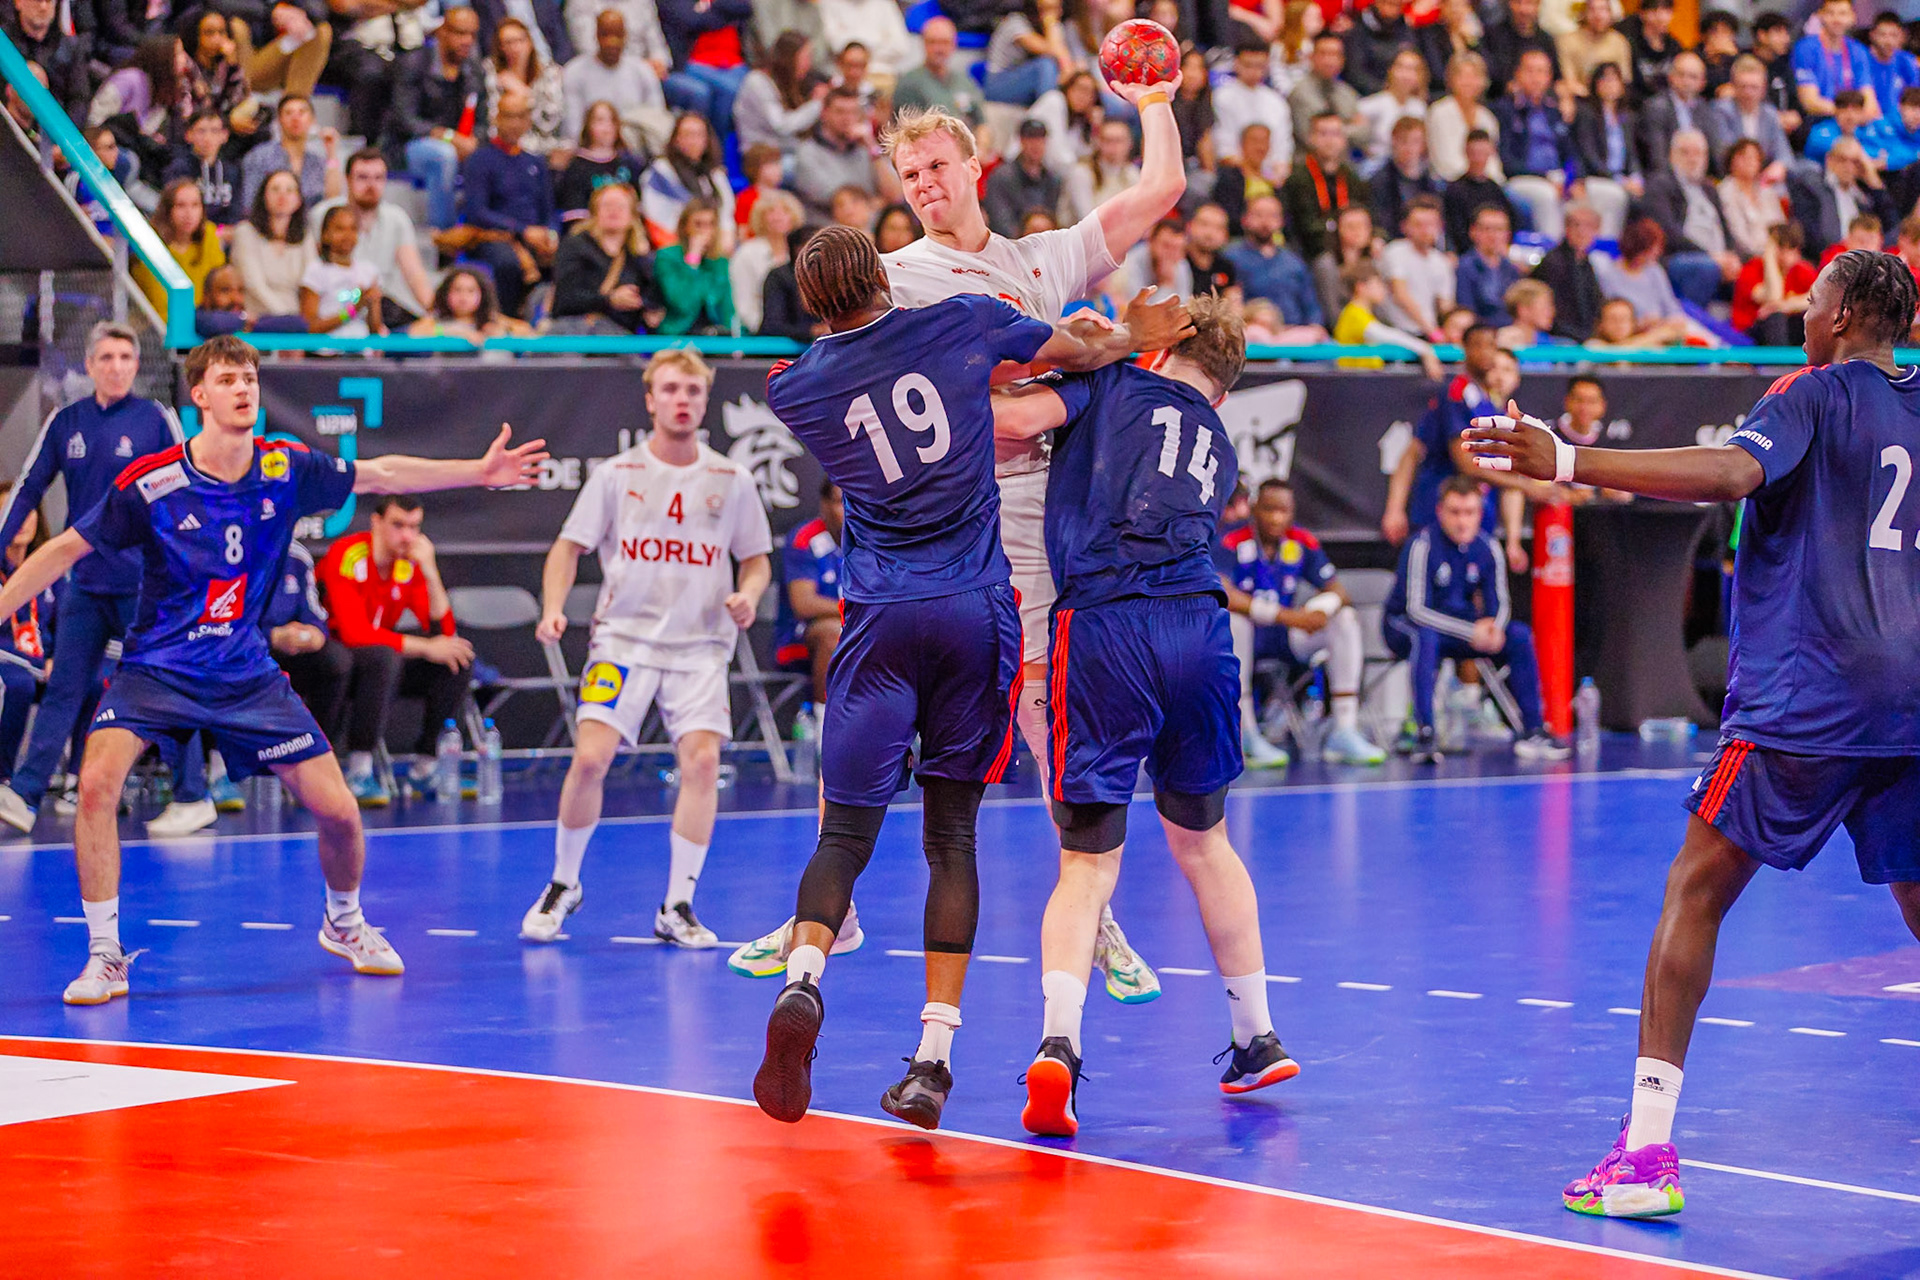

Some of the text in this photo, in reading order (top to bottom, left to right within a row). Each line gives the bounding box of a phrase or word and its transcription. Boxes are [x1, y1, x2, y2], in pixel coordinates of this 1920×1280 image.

[843, 372, 952, 485] 19
[1151, 405, 1219, 506] 14
[667, 491, 685, 525] 4
[1868, 444, 1920, 553] 2
[225, 524, 244, 566] 8
[621, 537, 722, 568] NORLY
